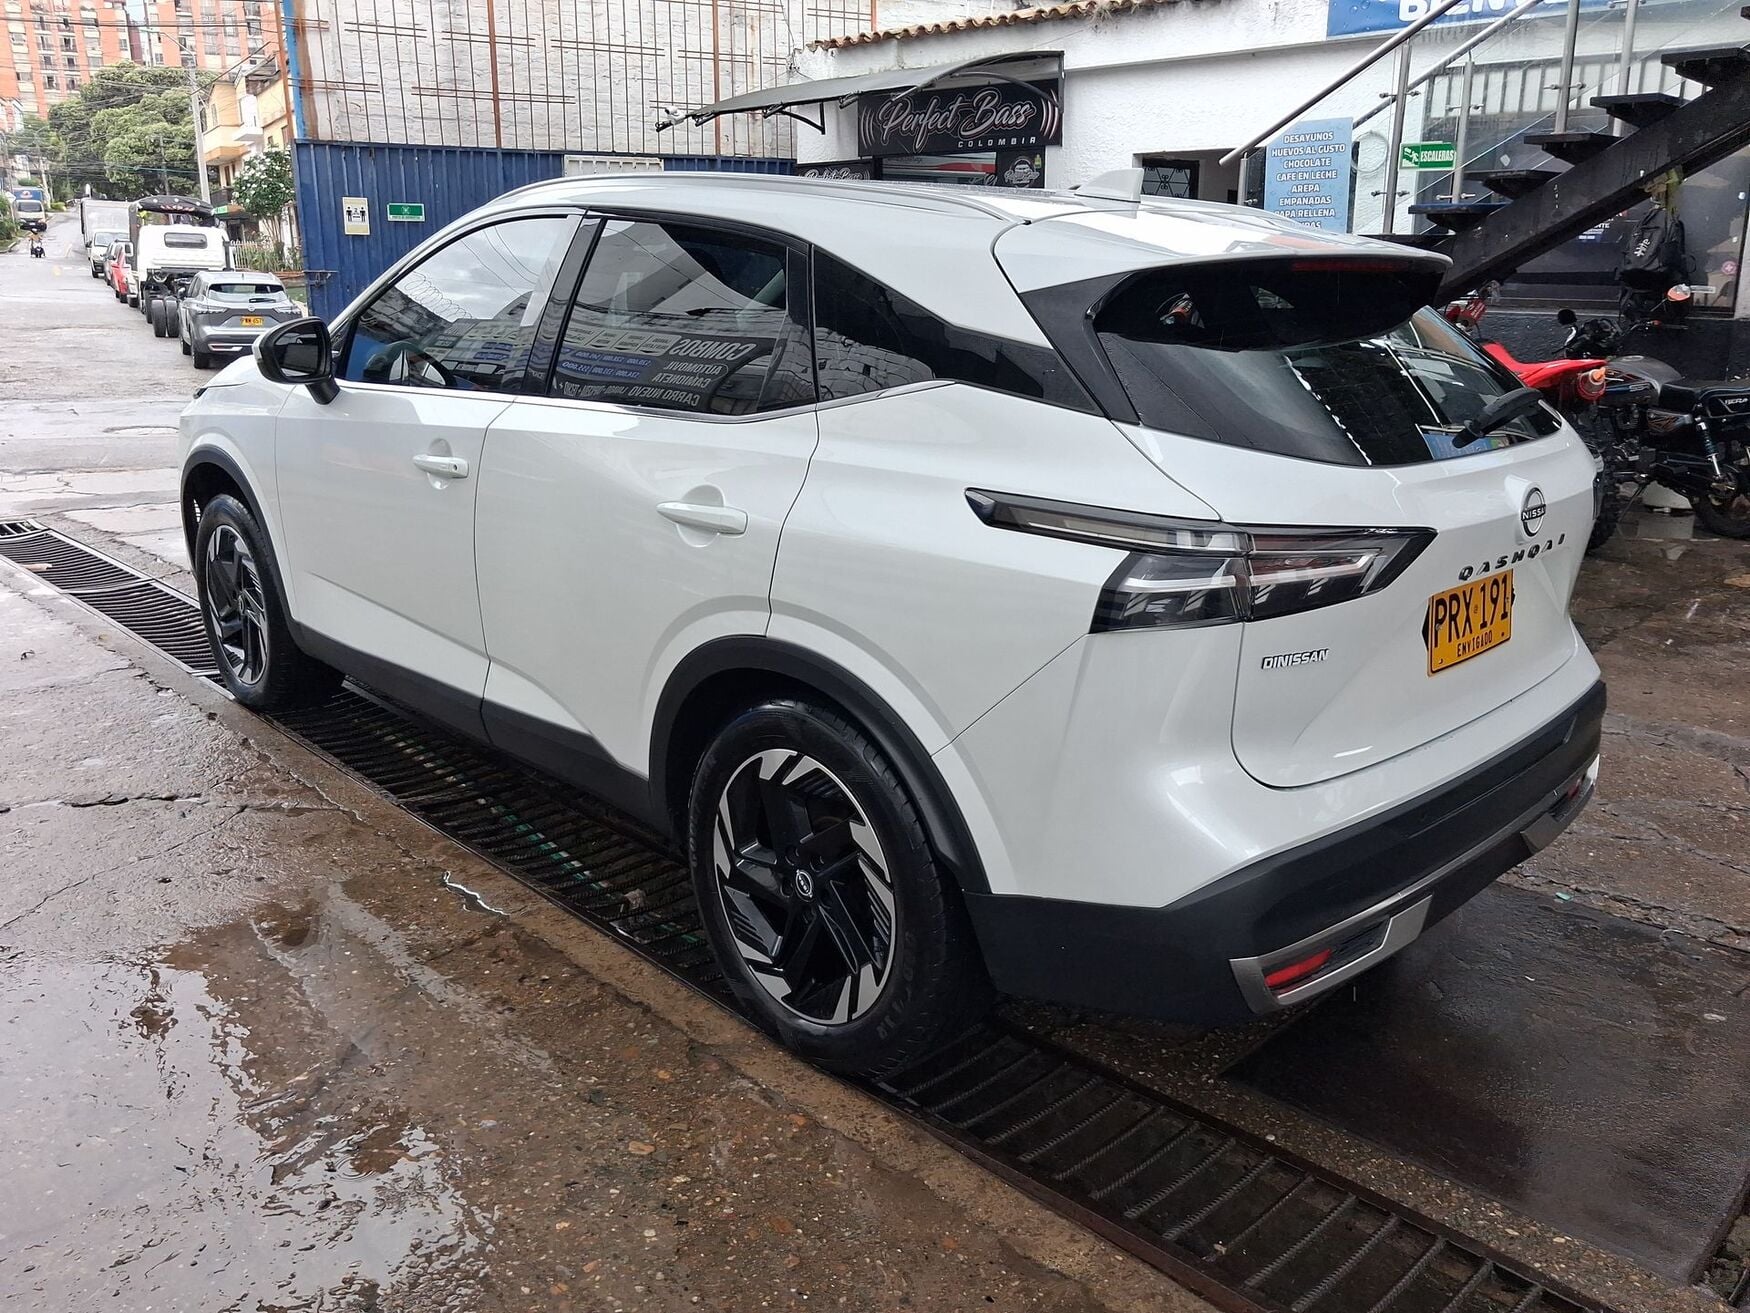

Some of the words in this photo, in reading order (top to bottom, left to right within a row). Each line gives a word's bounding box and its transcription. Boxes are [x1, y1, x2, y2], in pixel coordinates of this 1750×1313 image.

[878, 97, 966, 152] Perfect
[958, 88, 1037, 140] Bass
[957, 136, 1037, 148] COLOMBIA
[1284, 131, 1334, 144] DESAYUNOS
[1271, 146, 1304, 157] HUEVOS
[1305, 146, 1317, 155] AL
[1318, 144, 1346, 154] GUSTO
[1420, 150, 1454, 162] ESCALERAS
[1283, 158, 1331, 169] CHOCOLATE
[1276, 171, 1298, 182] CAFE
[1298, 171, 1310, 180] EN
[1311, 170, 1338, 180] LECHE
[1291, 184, 1321, 193] AREPA
[1279, 196, 1332, 206] EMPANADAS
[1298, 208, 1336, 218] RELLENA
[1458, 533, 1566, 581] QASHQAI
[1434, 587, 1474, 648] PRX
[1479, 573, 1509, 630] 191
[1457, 630, 1493, 658] ENVIGADO
[1261, 649, 1330, 670] DINISSAN
